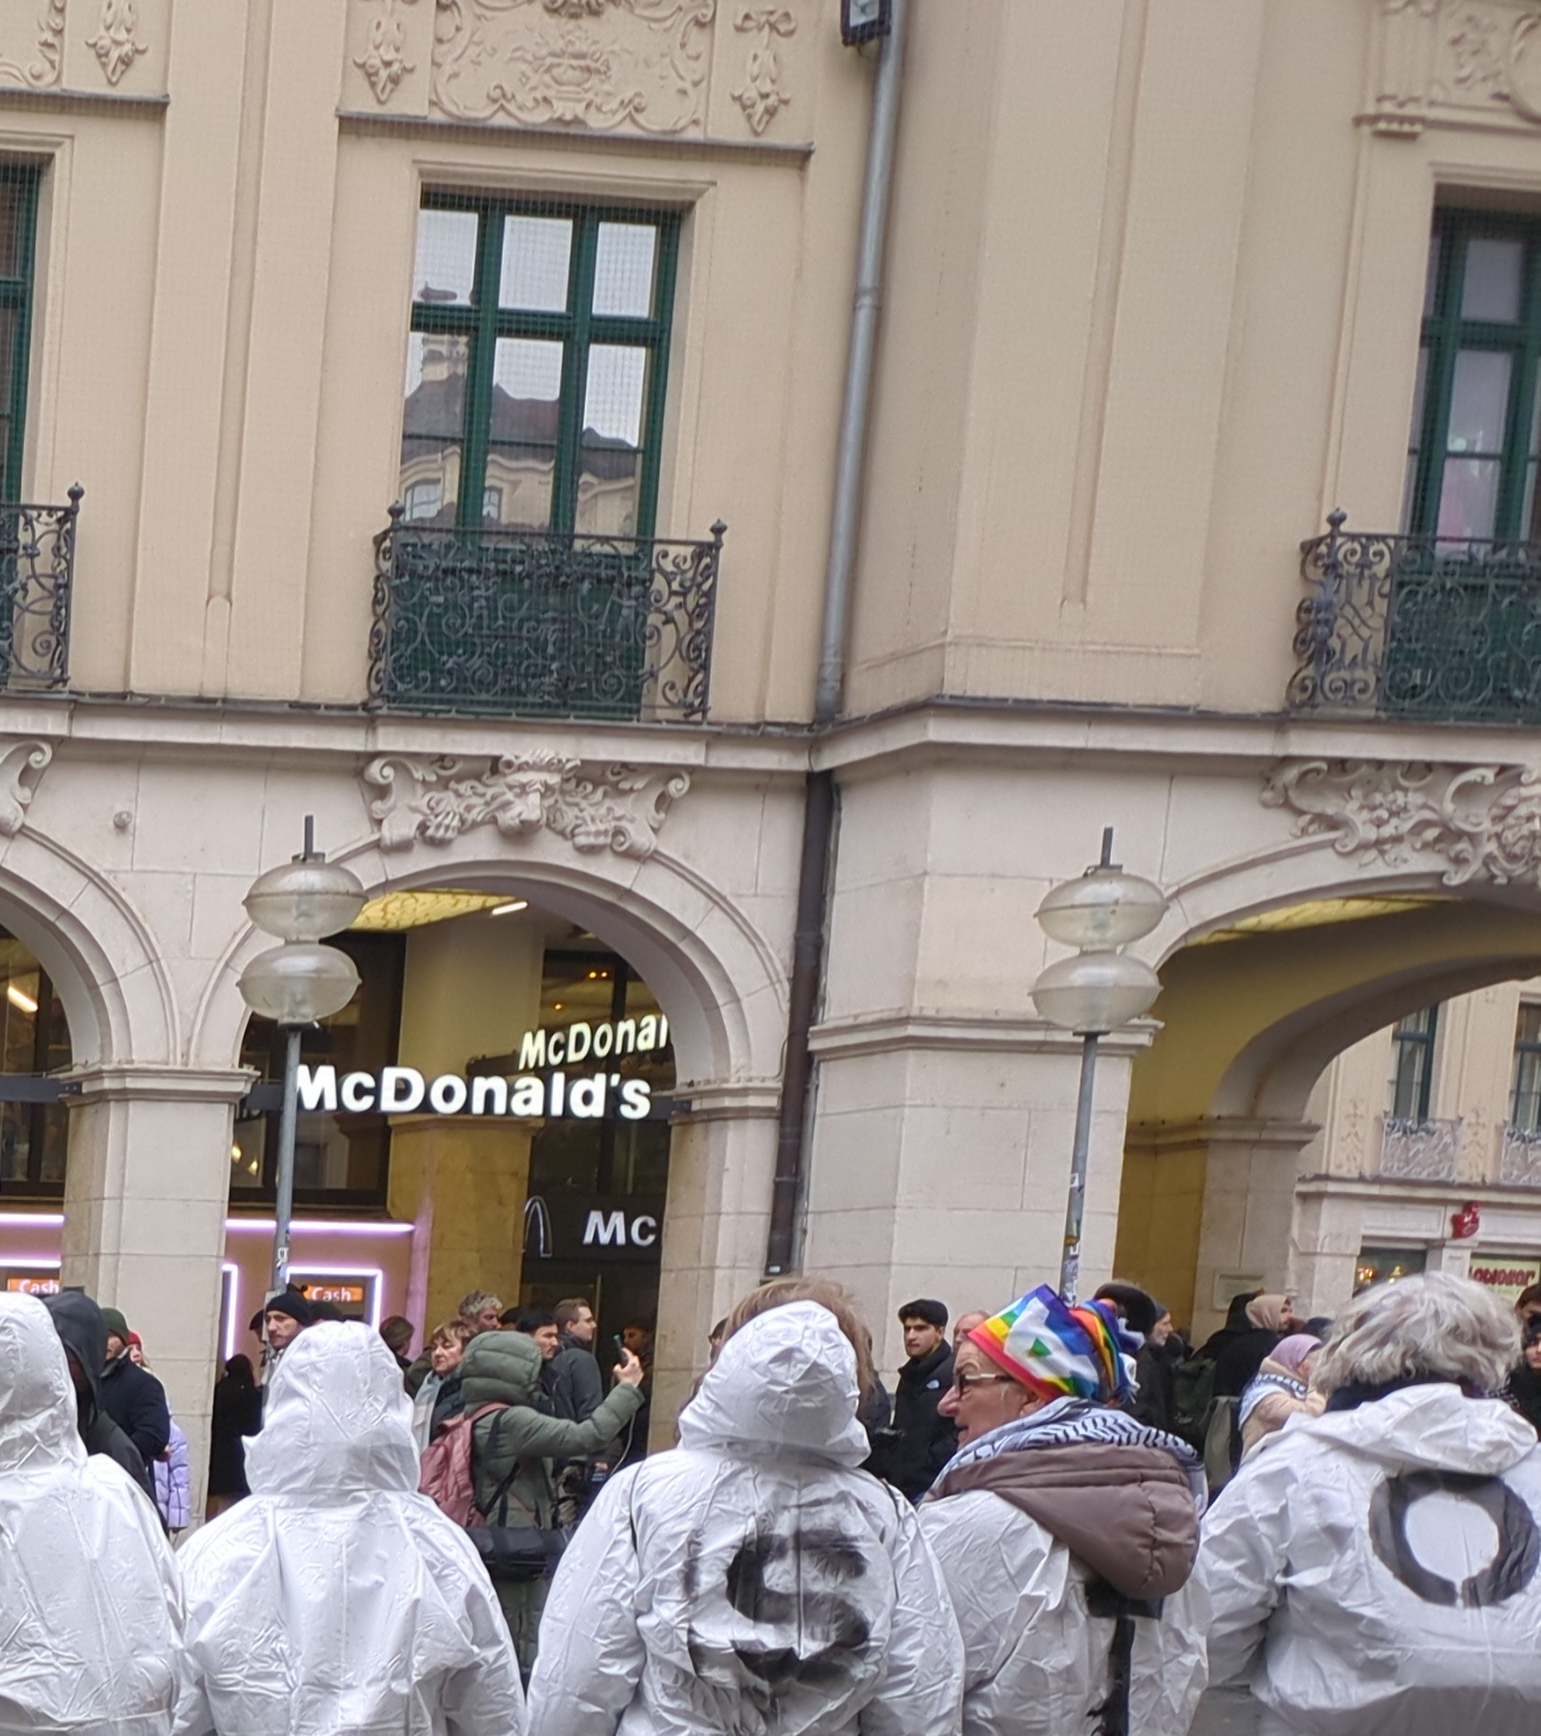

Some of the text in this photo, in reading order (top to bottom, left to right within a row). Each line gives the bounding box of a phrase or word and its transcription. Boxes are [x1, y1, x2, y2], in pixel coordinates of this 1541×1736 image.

[295, 1064, 652, 1120] McDonald's
[583, 1210, 657, 1246] Mc
[19, 1280, 59, 1294] Cash
[312, 1286, 351, 1302] Cash
[1369, 1471, 1540, 1607] O
